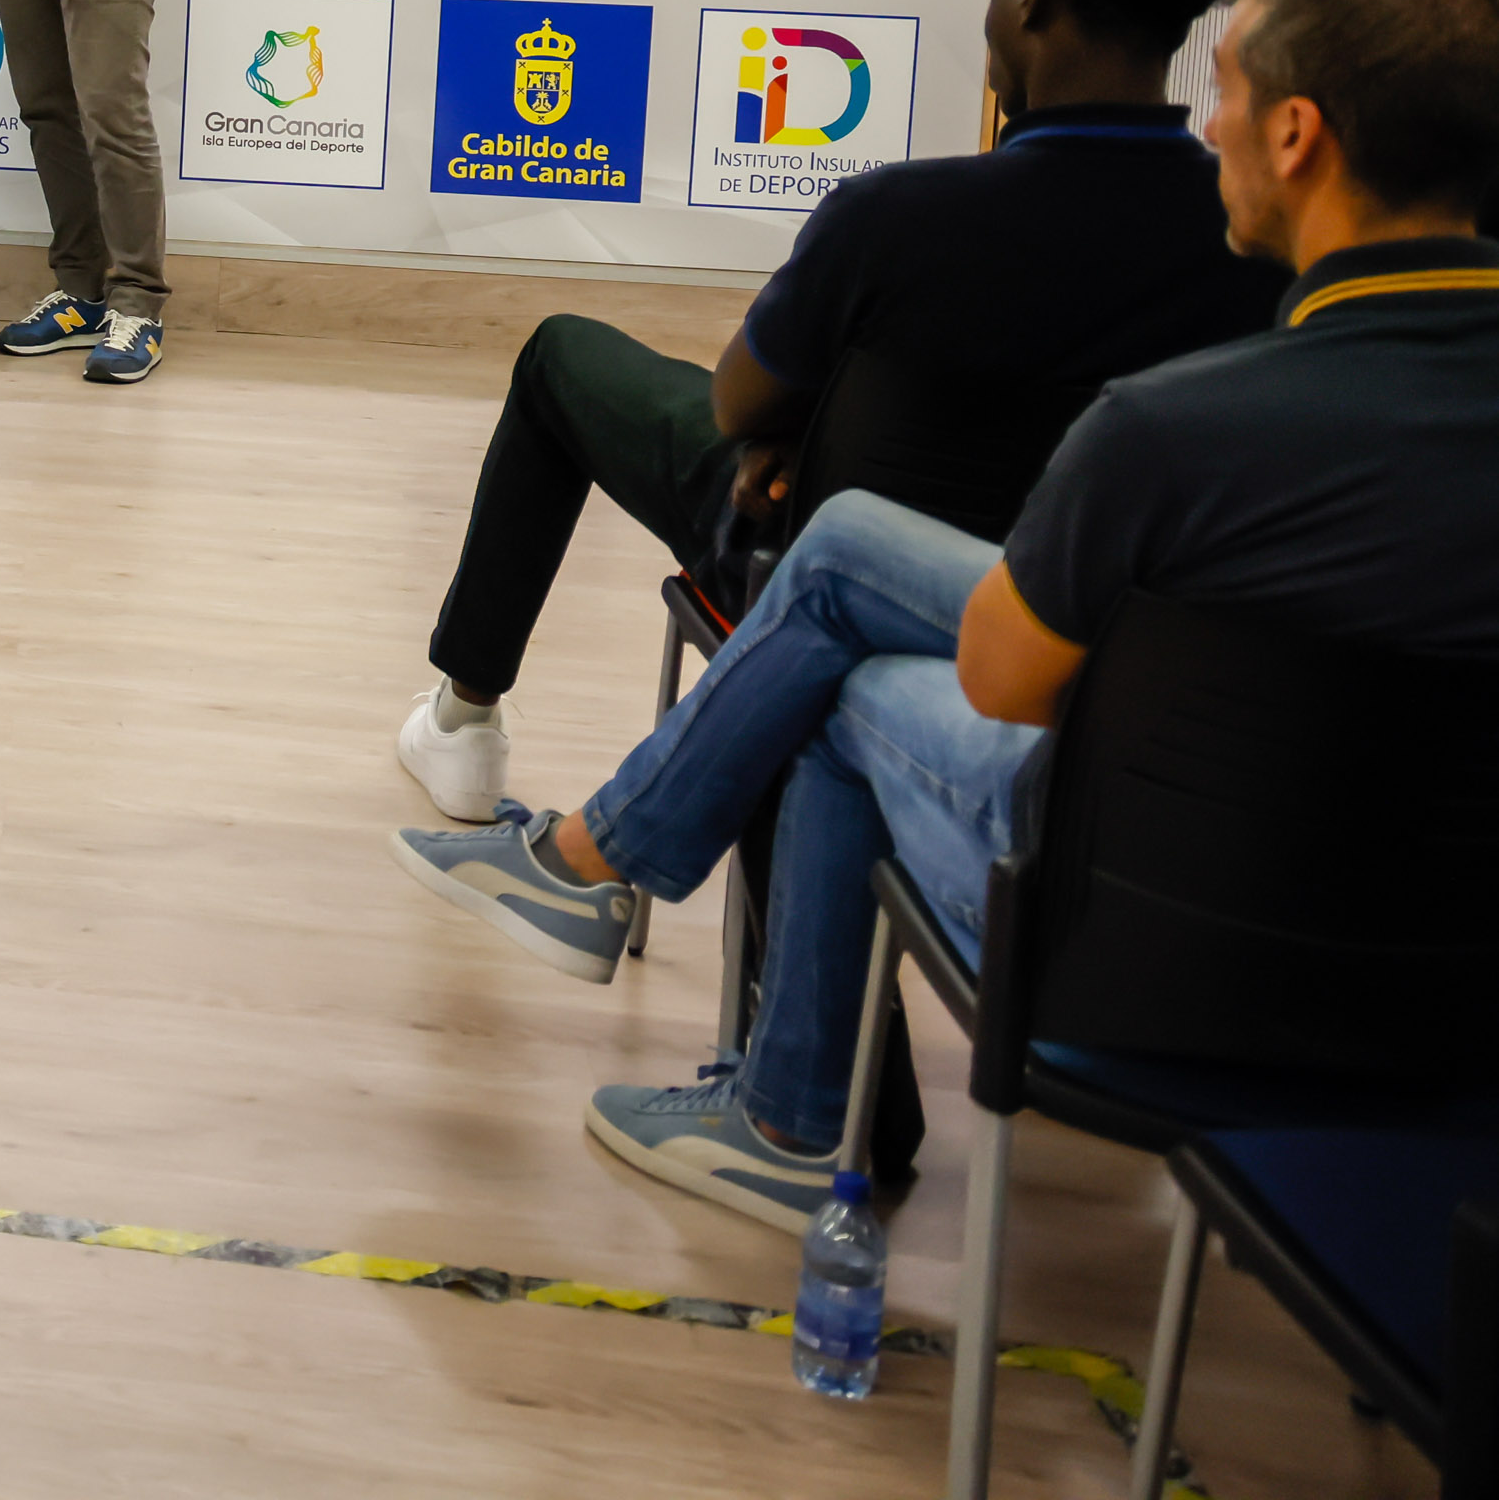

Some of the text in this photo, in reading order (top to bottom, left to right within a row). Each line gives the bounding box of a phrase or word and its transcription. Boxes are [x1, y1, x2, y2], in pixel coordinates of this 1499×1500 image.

[205, 111, 364, 139] Gran Canaria
[202, 135, 364, 154] Isla Europea del Deporte
[462, 132, 609, 161] Cabildo de
[447, 157, 626, 187] Gran Canaria
[720, 174, 839, 197] DE DEPOR
